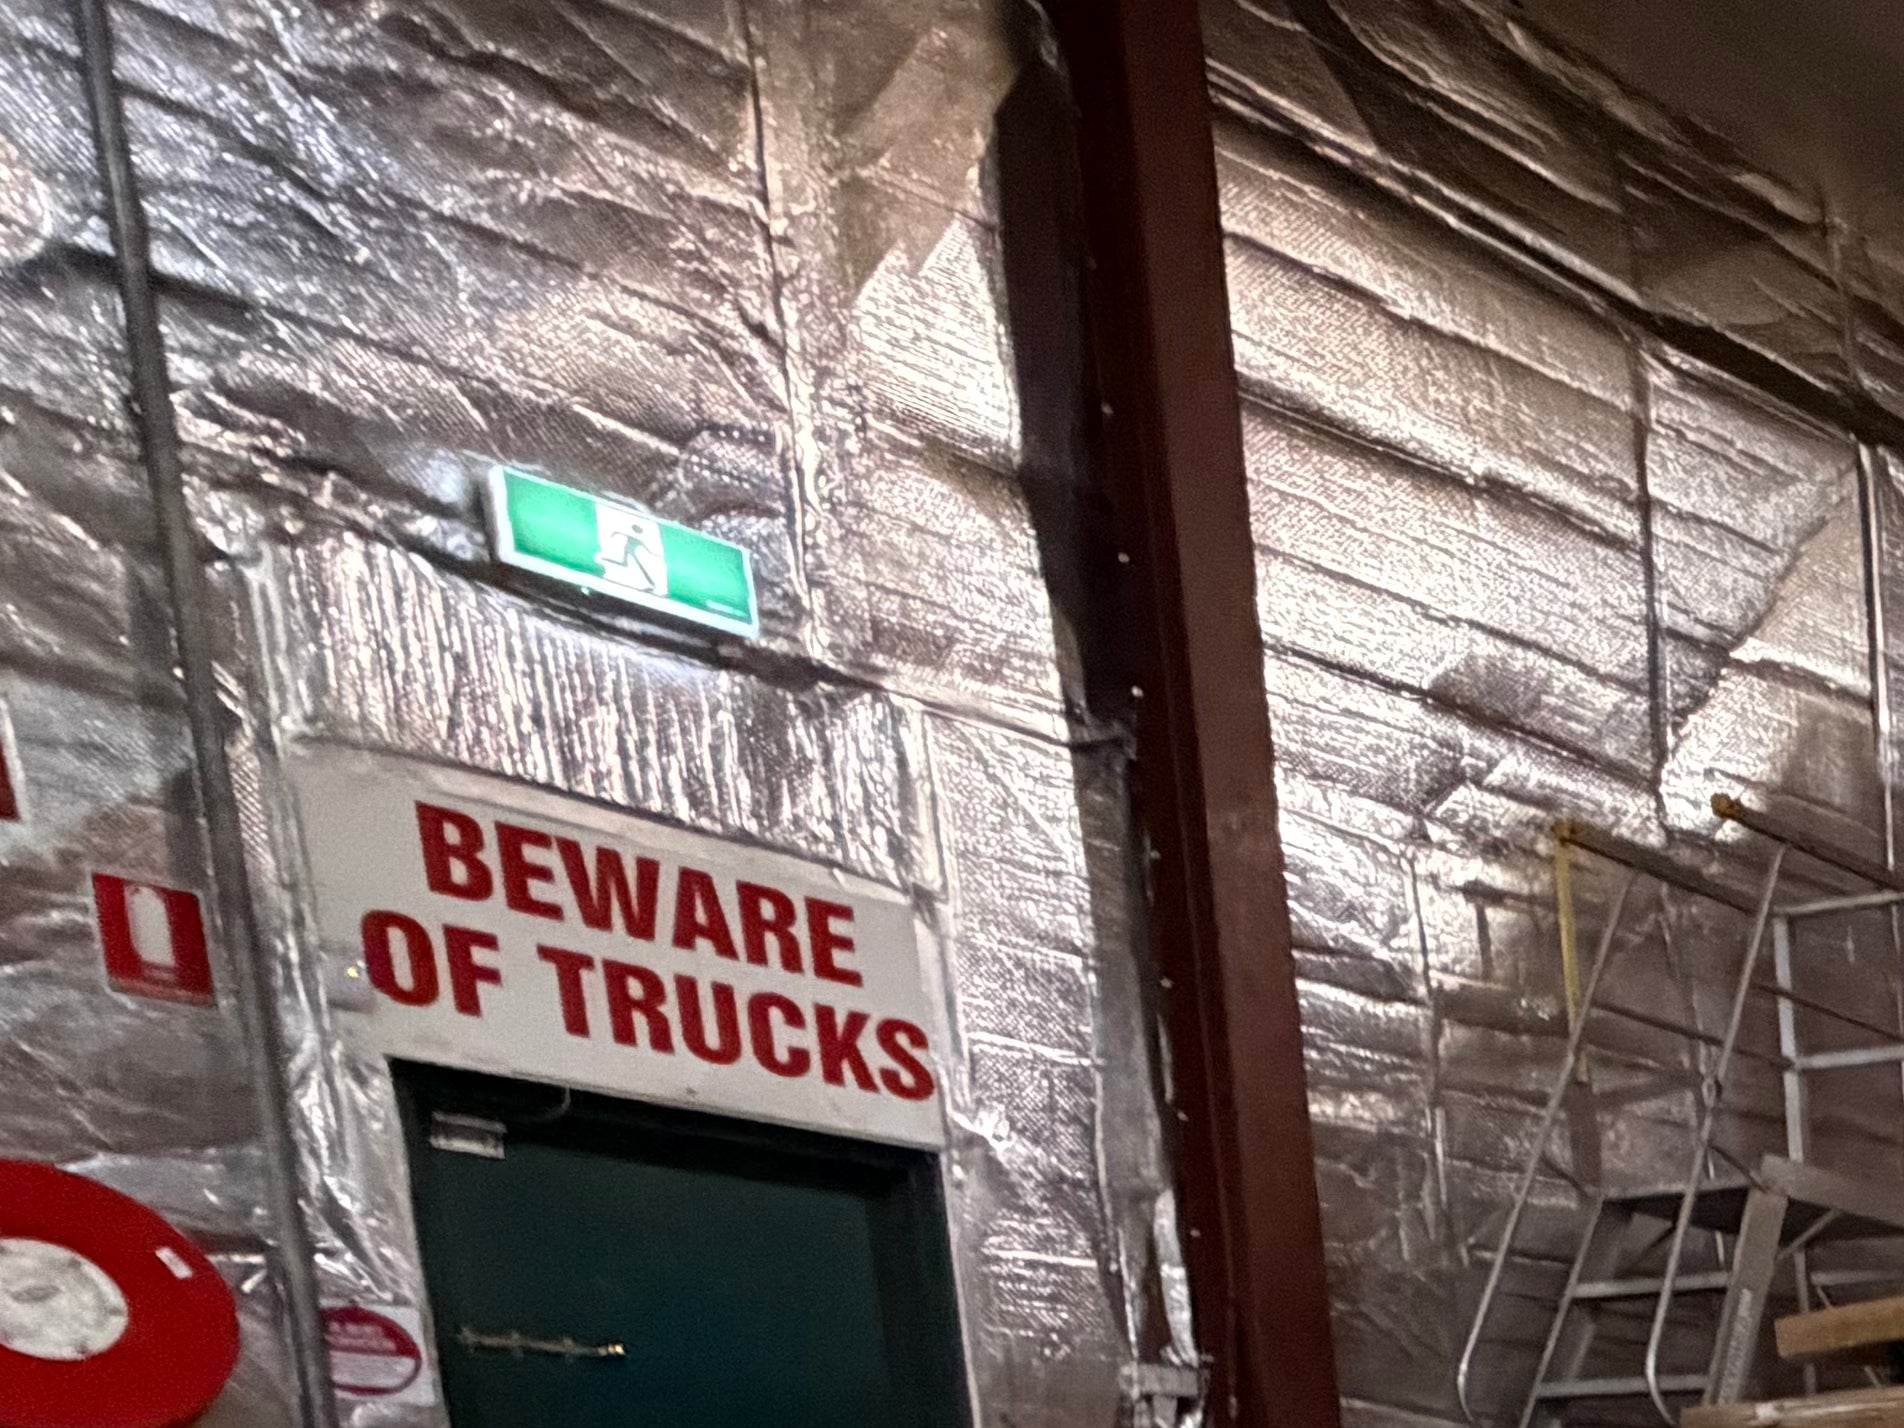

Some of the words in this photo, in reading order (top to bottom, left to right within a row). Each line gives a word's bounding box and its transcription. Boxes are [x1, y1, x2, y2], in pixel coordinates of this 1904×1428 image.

[415, 800, 864, 988] BEWARE
[360, 909, 502, 1018] OF
[536, 944, 936, 1101] TRUCKS
